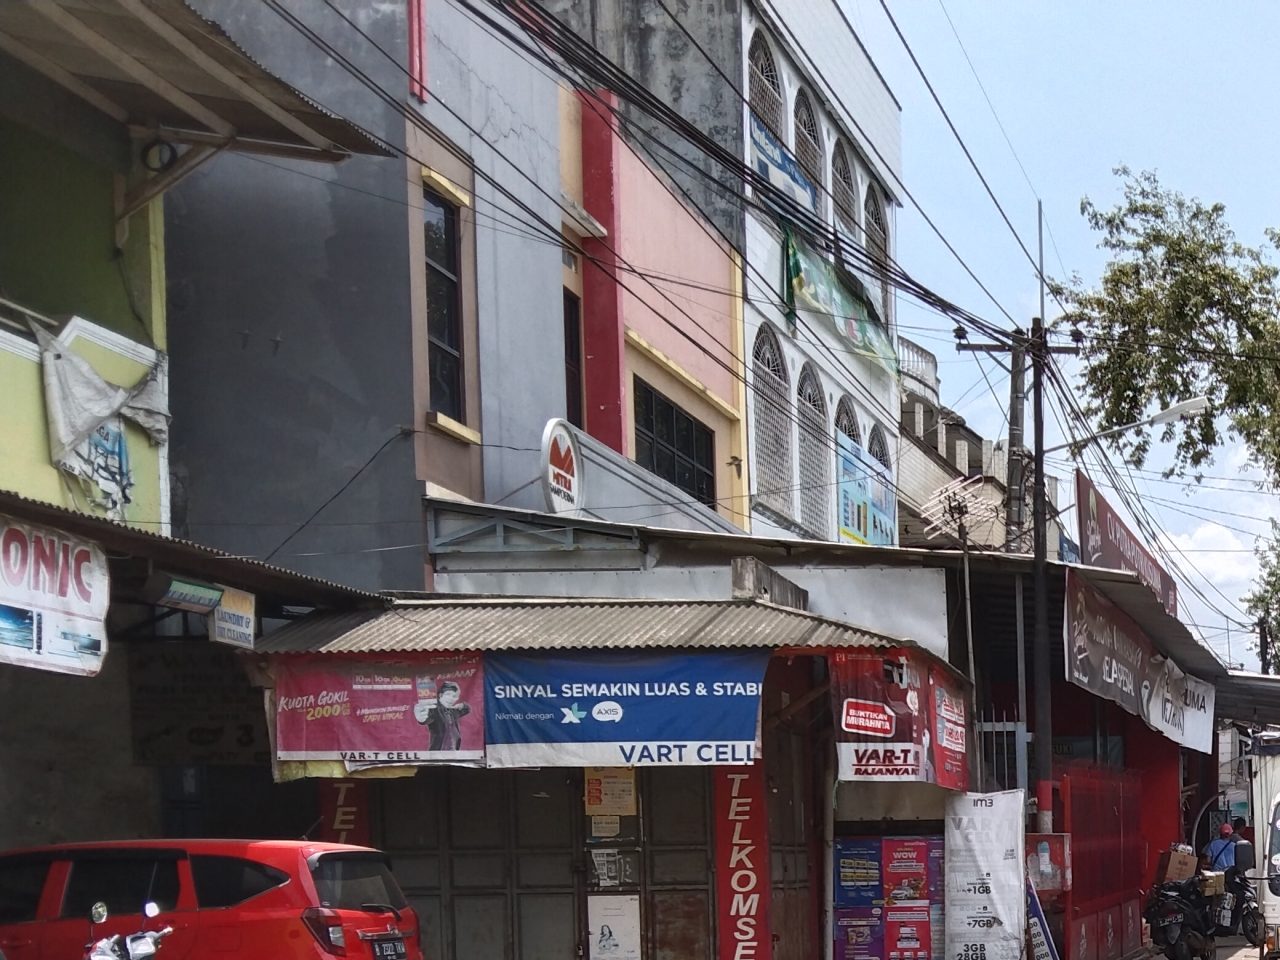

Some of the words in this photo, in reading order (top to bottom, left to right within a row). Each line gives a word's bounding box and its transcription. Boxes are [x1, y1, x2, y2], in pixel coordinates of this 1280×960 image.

[494, 684, 557, 699] SINYAL
[561, 683, 641, 697] SEMAKIN
[645, 683, 690, 696] LUAS
[695, 682, 708, 696] &
[278, 695, 315, 712] KUOTA
[317, 690, 350, 705] GOKIL
[306, 704, 341, 721] 2000
[495, 712, 524, 720] Nikmati
[525, 711, 555, 721] dengan
[596, 708, 619, 716] AXIS
[849, 709, 888, 721] BUKTIKAN
[340, 752, 380, 760] VAR-T
[387, 751, 421, 760] CELL
[619, 744, 688, 763] VART
[696, 744, 756, 762] CELL
[854, 749, 911, 764] VAR-T
[892, 851, 917, 859] WOW
[963, 943, 987, 953] 3GB
